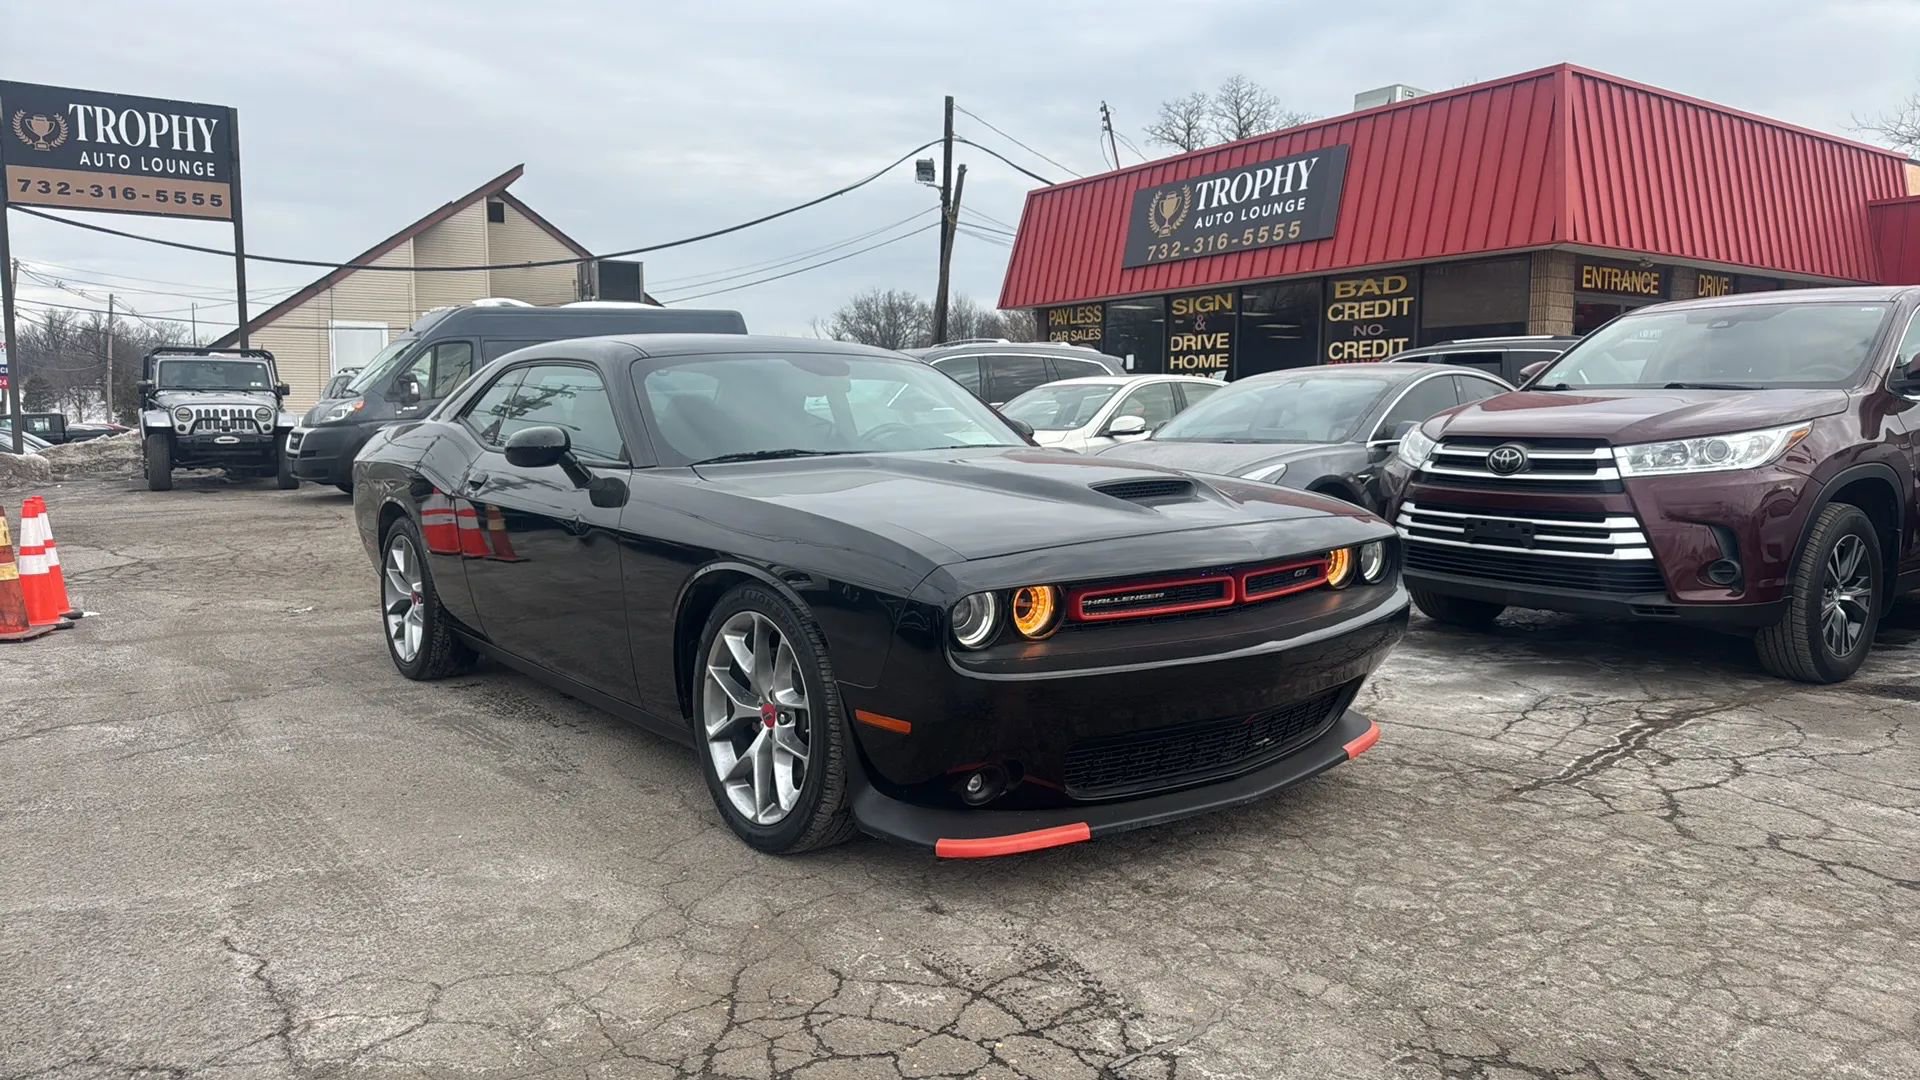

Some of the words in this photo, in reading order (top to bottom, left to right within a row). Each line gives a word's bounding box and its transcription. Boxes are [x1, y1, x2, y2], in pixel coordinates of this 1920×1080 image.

[68, 103, 219, 154] TROPHY
[79, 151, 131, 169] AUTO
[141, 155, 216, 177] LOUNGE
[16, 178, 223, 208] 732-316-5555
[1195, 157, 1319, 211] TROPHY
[1194, 211, 1233, 230] AUTO
[1241, 197, 1306, 221] LOUNGE
[1147, 220, 1301, 262] 732-316-5555
[1334, 275, 1408, 299] BAD
[1582, 265, 1660, 295] ENTRANCE
[1048, 304, 1102, 326] PAYLESS
[1171, 293, 1233, 316] SIGN
[1327, 297, 1415, 322] CREDIT
[1194, 314, 1206, 331] &
[1353, 323, 1383, 337] NO
[1049, 330, 1069, 342] CAR
[1070, 328, 1101, 342] SALES
[1170, 332, 1230, 352] DRIVE
[1328, 337, 1409, 360] CREDIT
[1169, 353, 1229, 370] HOME
